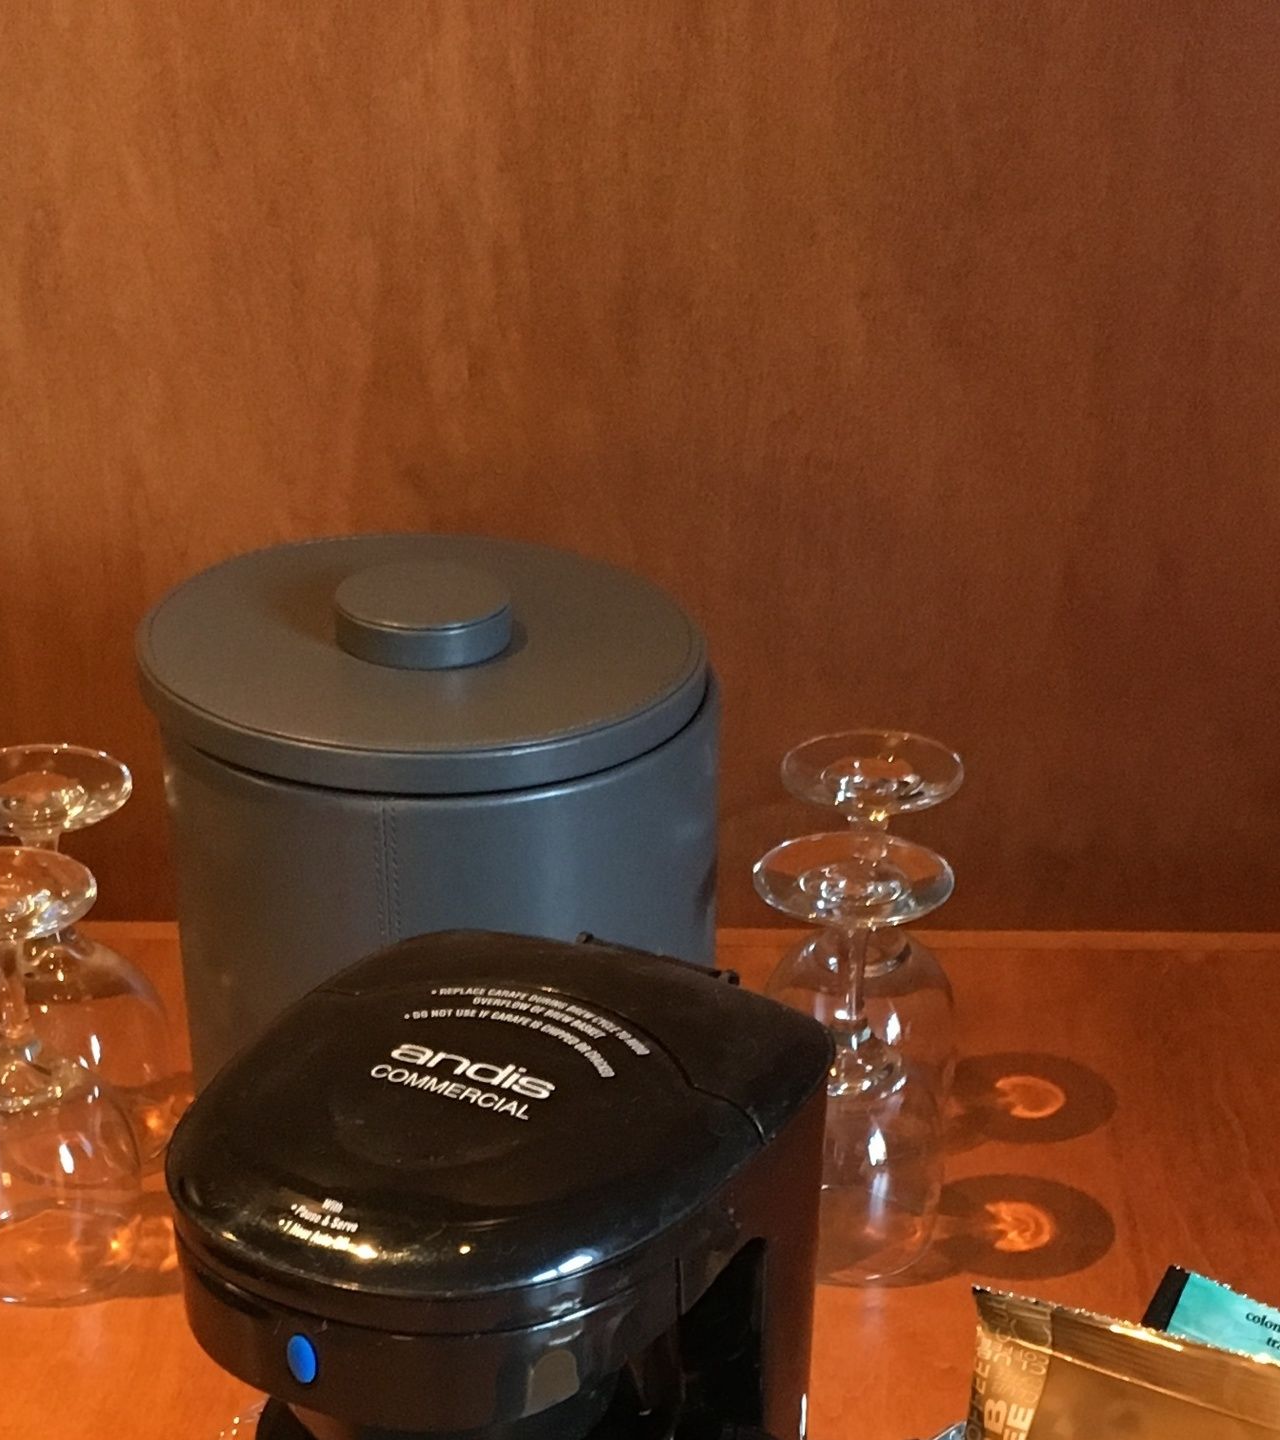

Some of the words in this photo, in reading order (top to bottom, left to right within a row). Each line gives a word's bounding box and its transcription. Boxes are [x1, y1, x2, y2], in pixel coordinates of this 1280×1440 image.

[439, 987, 486, 996] REPLACE
[487, 989, 529, 1000] CARAFE
[528, 994, 568, 1010] DURING
[565, 1005, 597, 1019] BREW
[591, 1016, 622, 1033] CYCLE
[615, 1030, 632, 1040] TO
[472, 996, 531, 1011] OVERFLOW
[529, 1005, 546, 1014] OF
[543, 1009, 575, 1023] BREW
[569, 1019, 606, 1039] BASKET
[412, 1010, 428, 1019] DO
[431, 1009, 453, 1018] NOT
[455, 1009, 477, 1018] USE
[478, 1010, 491, 1018] IF
[490, 1011, 532, 1026] CARAFE
[529, 1020, 543, 1030] IS
[540, 1024, 580, 1046] CHIPPED
[573, 1042, 592, 1053] OR
[584, 1050, 615, 1077] CRACKED
[370, 1064, 529, 1121] COMMERCIAL
[391, 1043, 555, 1099] andis
[294, 1205, 322, 1224] Pause
[320, 1215, 331, 1227] &
[330, 1217, 359, 1233] Serve
